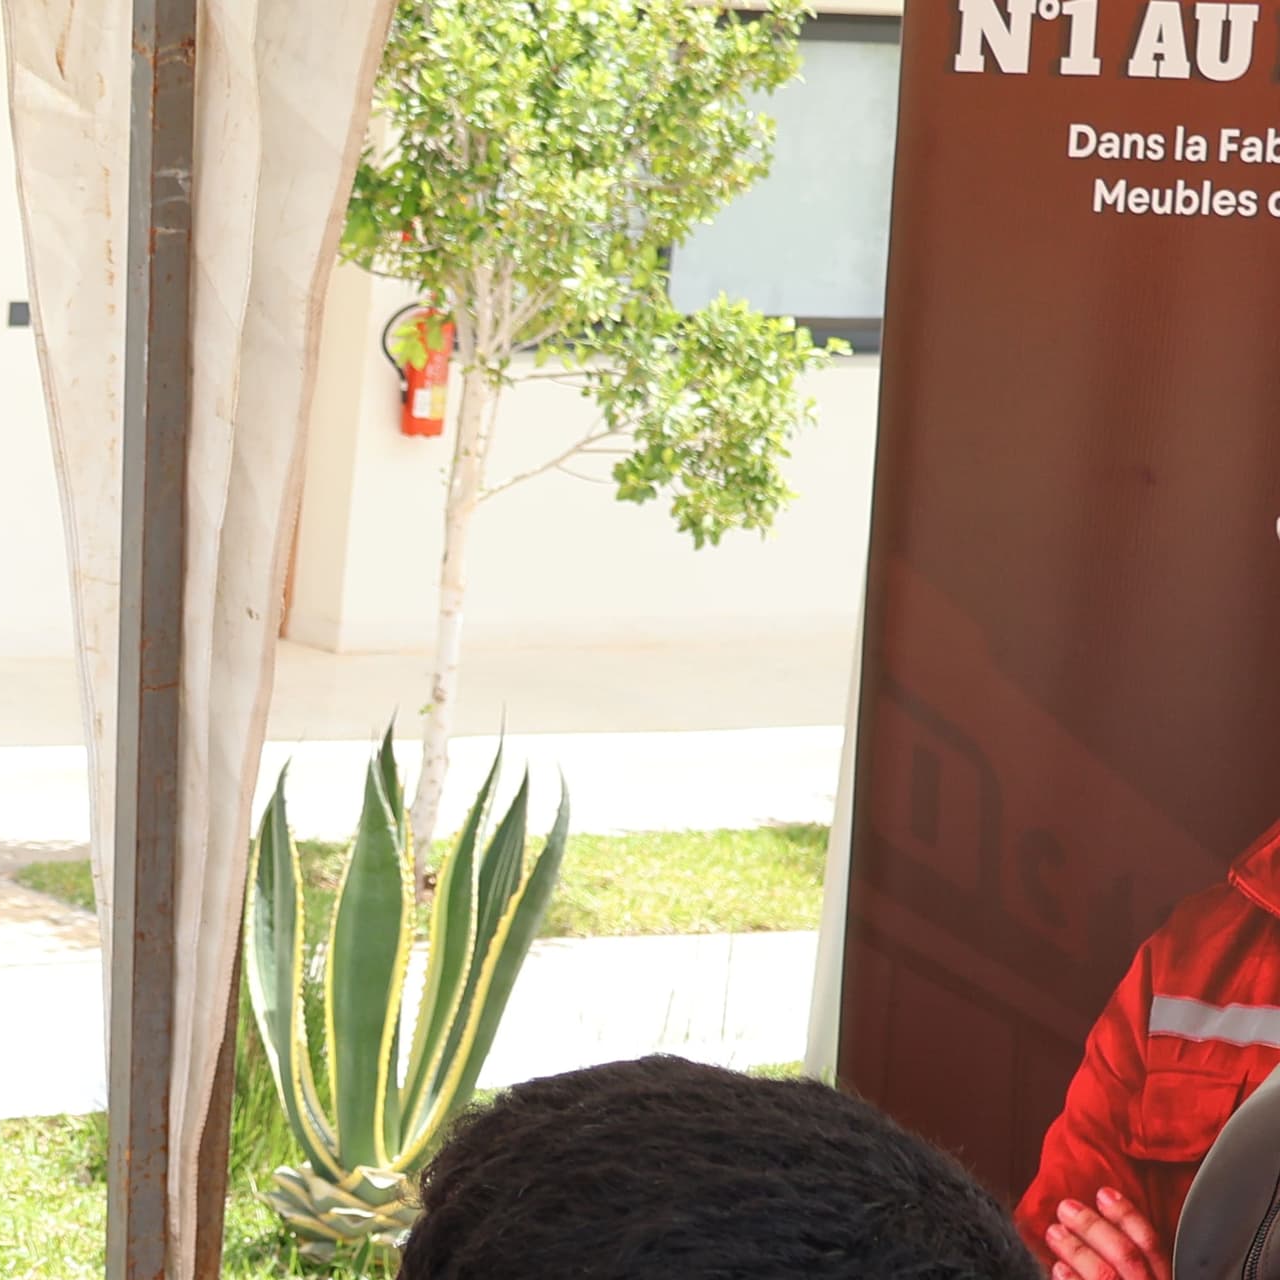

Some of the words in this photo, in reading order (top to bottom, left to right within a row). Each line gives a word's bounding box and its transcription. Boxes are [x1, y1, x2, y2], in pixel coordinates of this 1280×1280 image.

[1128, 0, 1260, 82] AU
[1067, 123, 1165, 161] Dans
[1174, 125, 1208, 163] la
[1093, 178, 1258, 217] Meubles
